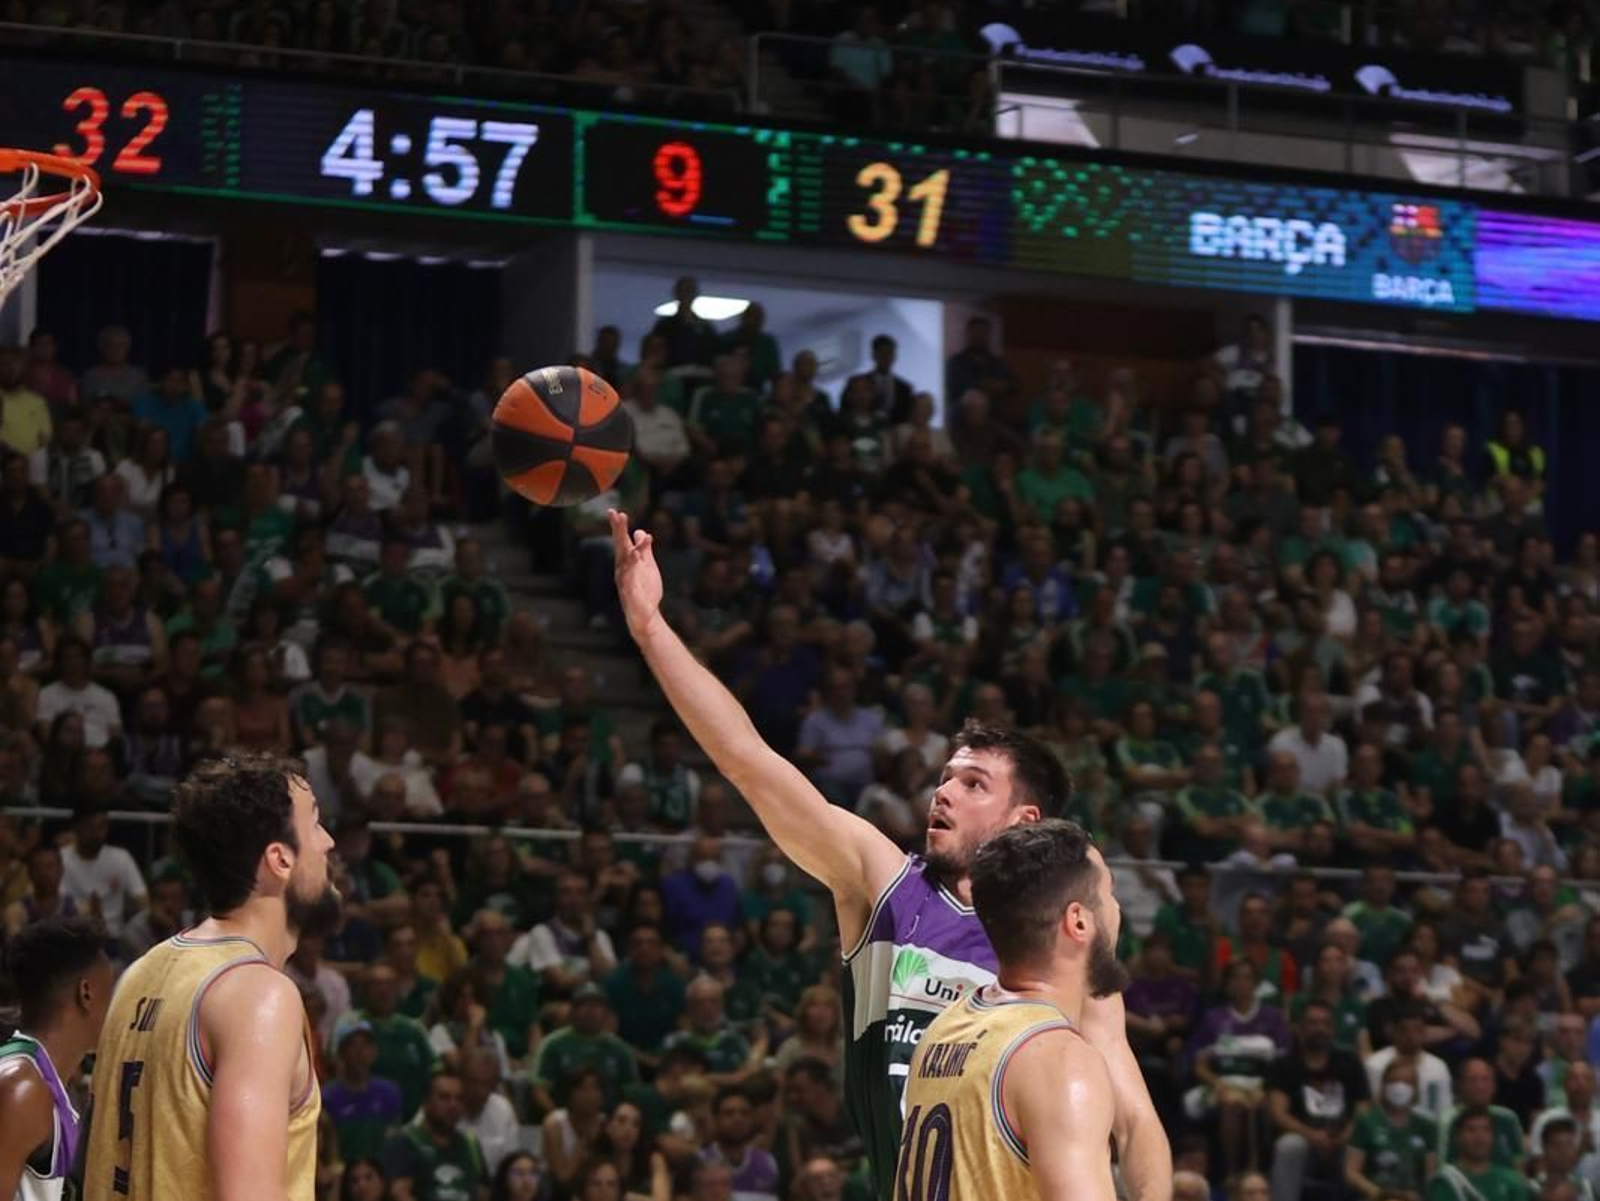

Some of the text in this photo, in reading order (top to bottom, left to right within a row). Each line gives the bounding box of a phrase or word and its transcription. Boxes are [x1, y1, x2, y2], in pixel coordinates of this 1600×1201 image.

[54, 87, 169, 174] 32
[320, 109, 539, 208] 4:57
[653, 141, 701, 216] 9
[847, 162, 951, 247] 31
[1189, 211, 1346, 275] BARÇA
